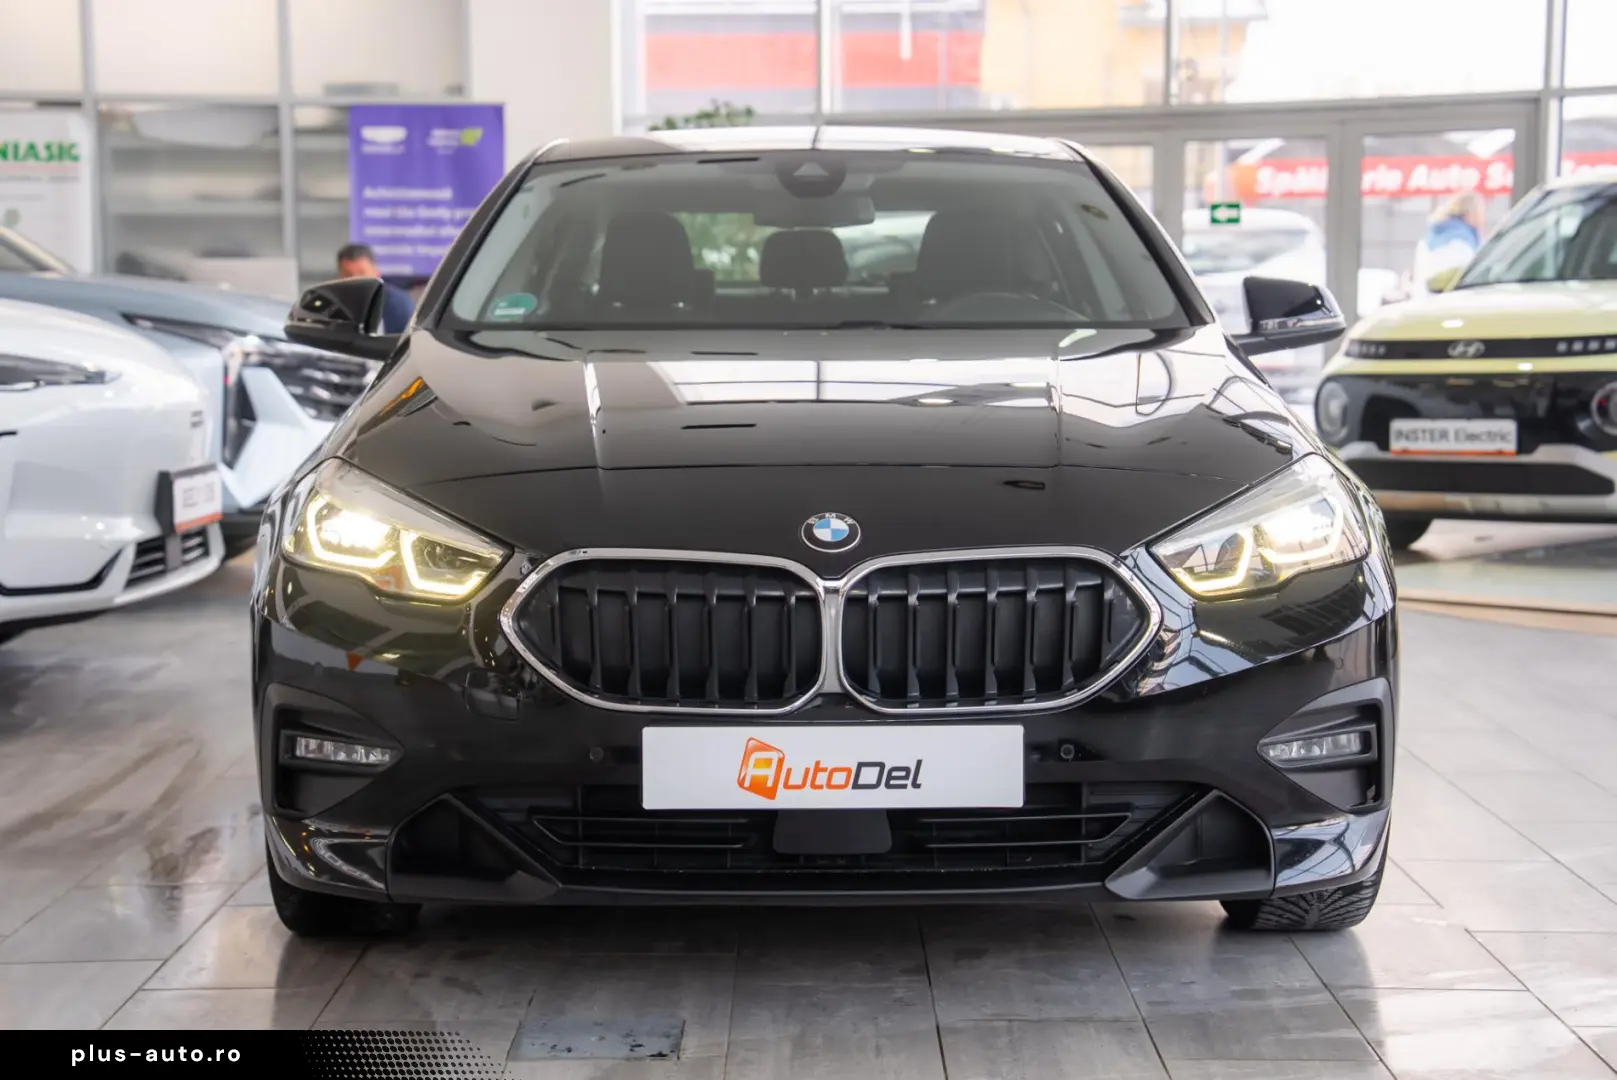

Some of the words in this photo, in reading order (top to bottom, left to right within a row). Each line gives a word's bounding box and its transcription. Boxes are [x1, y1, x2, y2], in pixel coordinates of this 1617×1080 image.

[1406, 163, 1481, 191] Auto
[1455, 427, 1512, 443] Electric
[808, 513, 855, 524] BMW
[746, 752, 923, 790] AutoDel
